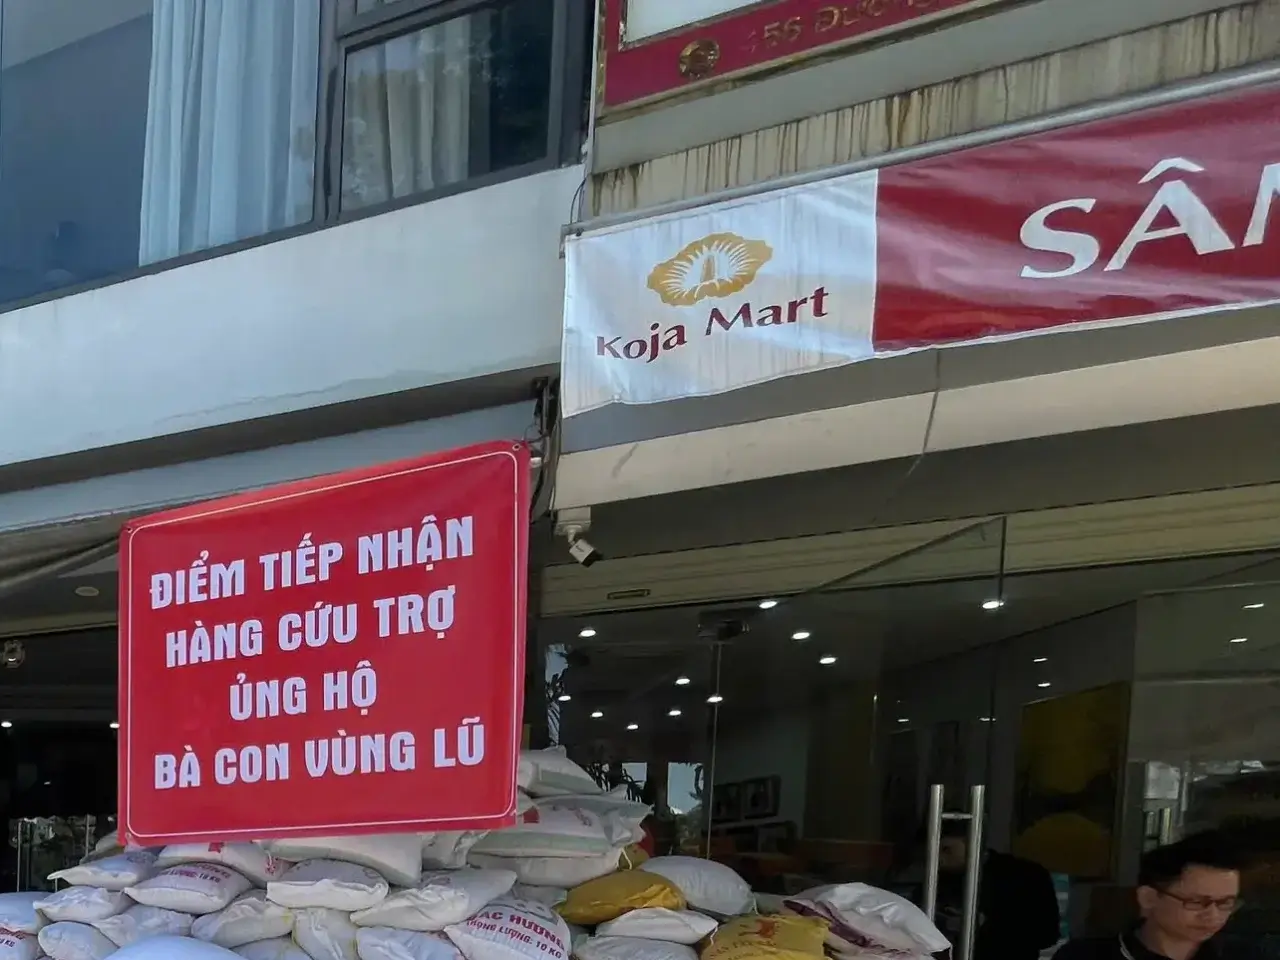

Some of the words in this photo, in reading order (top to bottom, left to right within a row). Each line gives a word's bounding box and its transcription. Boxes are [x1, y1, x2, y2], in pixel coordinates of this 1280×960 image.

[596, 321, 687, 365] Koja
[704, 285, 830, 338] Mart
[149, 549, 245, 610] ĐIỂM
[259, 531, 343, 591] TIẾP
[357, 514, 474, 574] NHẬN
[165, 619, 263, 669] HÀNG
[278, 601, 358, 652] CỨU
[373, 584, 456, 640] TRỢ
[229, 672, 308, 721] ỦNG
[323, 659, 378, 716] HỘ
[153, 744, 201, 790] BÀ
[214, 742, 290, 785] CON
[304, 728, 416, 779] VÙNG
[433, 717, 486, 768] LŨ
[535, 939, 547, 951] 10
[549, 949, 562, 960] KG
